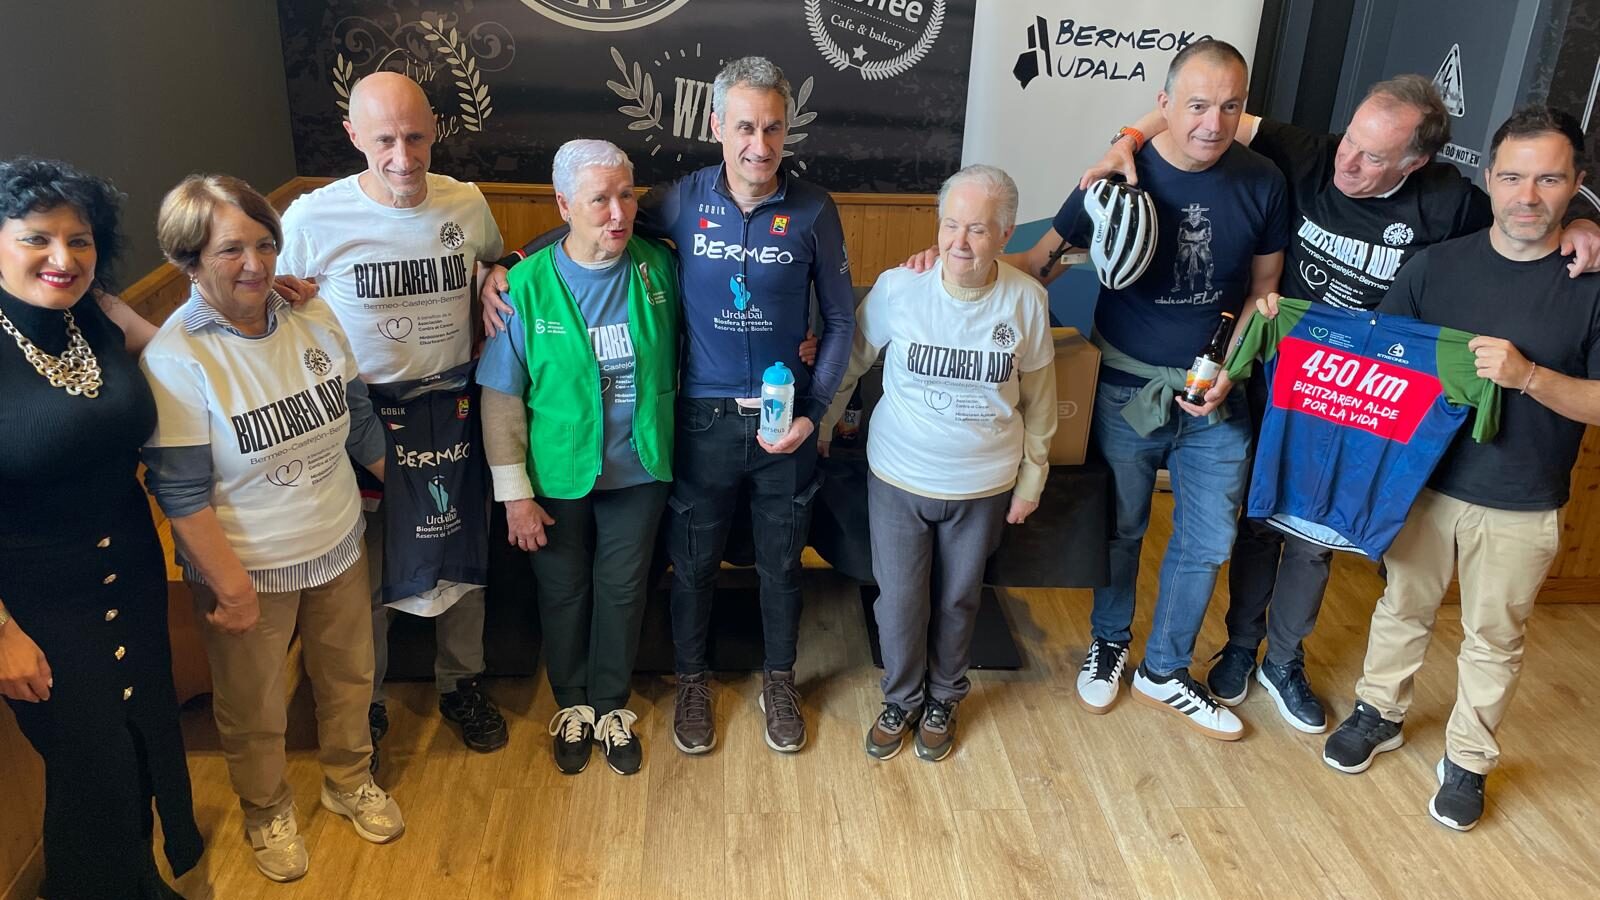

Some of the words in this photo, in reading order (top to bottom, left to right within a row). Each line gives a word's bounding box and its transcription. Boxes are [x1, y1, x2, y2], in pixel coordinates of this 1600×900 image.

[831, 14, 855, 31] Cafe
[857, 24, 867, 36] &
[869, 27, 905, 51] bakery
[1055, 19, 1214, 51] BERMEOK
[1057, 56, 1145, 82] UDALA
[673, 77, 717, 143] WI
[1446, 145, 1455, 158] DO
[1456, 149, 1469, 162] NOT
[693, 233, 794, 264] BERMEO
[353, 258, 439, 299] BIZITZAREN
[907, 342, 983, 381] BIZITZAREN
[1302, 350, 1360, 388] 450
[1356, 364, 1409, 403] km
[381, 407, 406, 415] GOBIK
[1293, 380, 1363, 409] BIZITZAREN
[1364, 399, 1399, 420] ALDE
[1302, 398, 1327, 415] POR
[1330, 407, 1347, 421] LA
[1350, 412, 1378, 430] VIDA
[231, 389, 325, 455] BIZITZAREN
[395, 442, 470, 468] BERMEO
